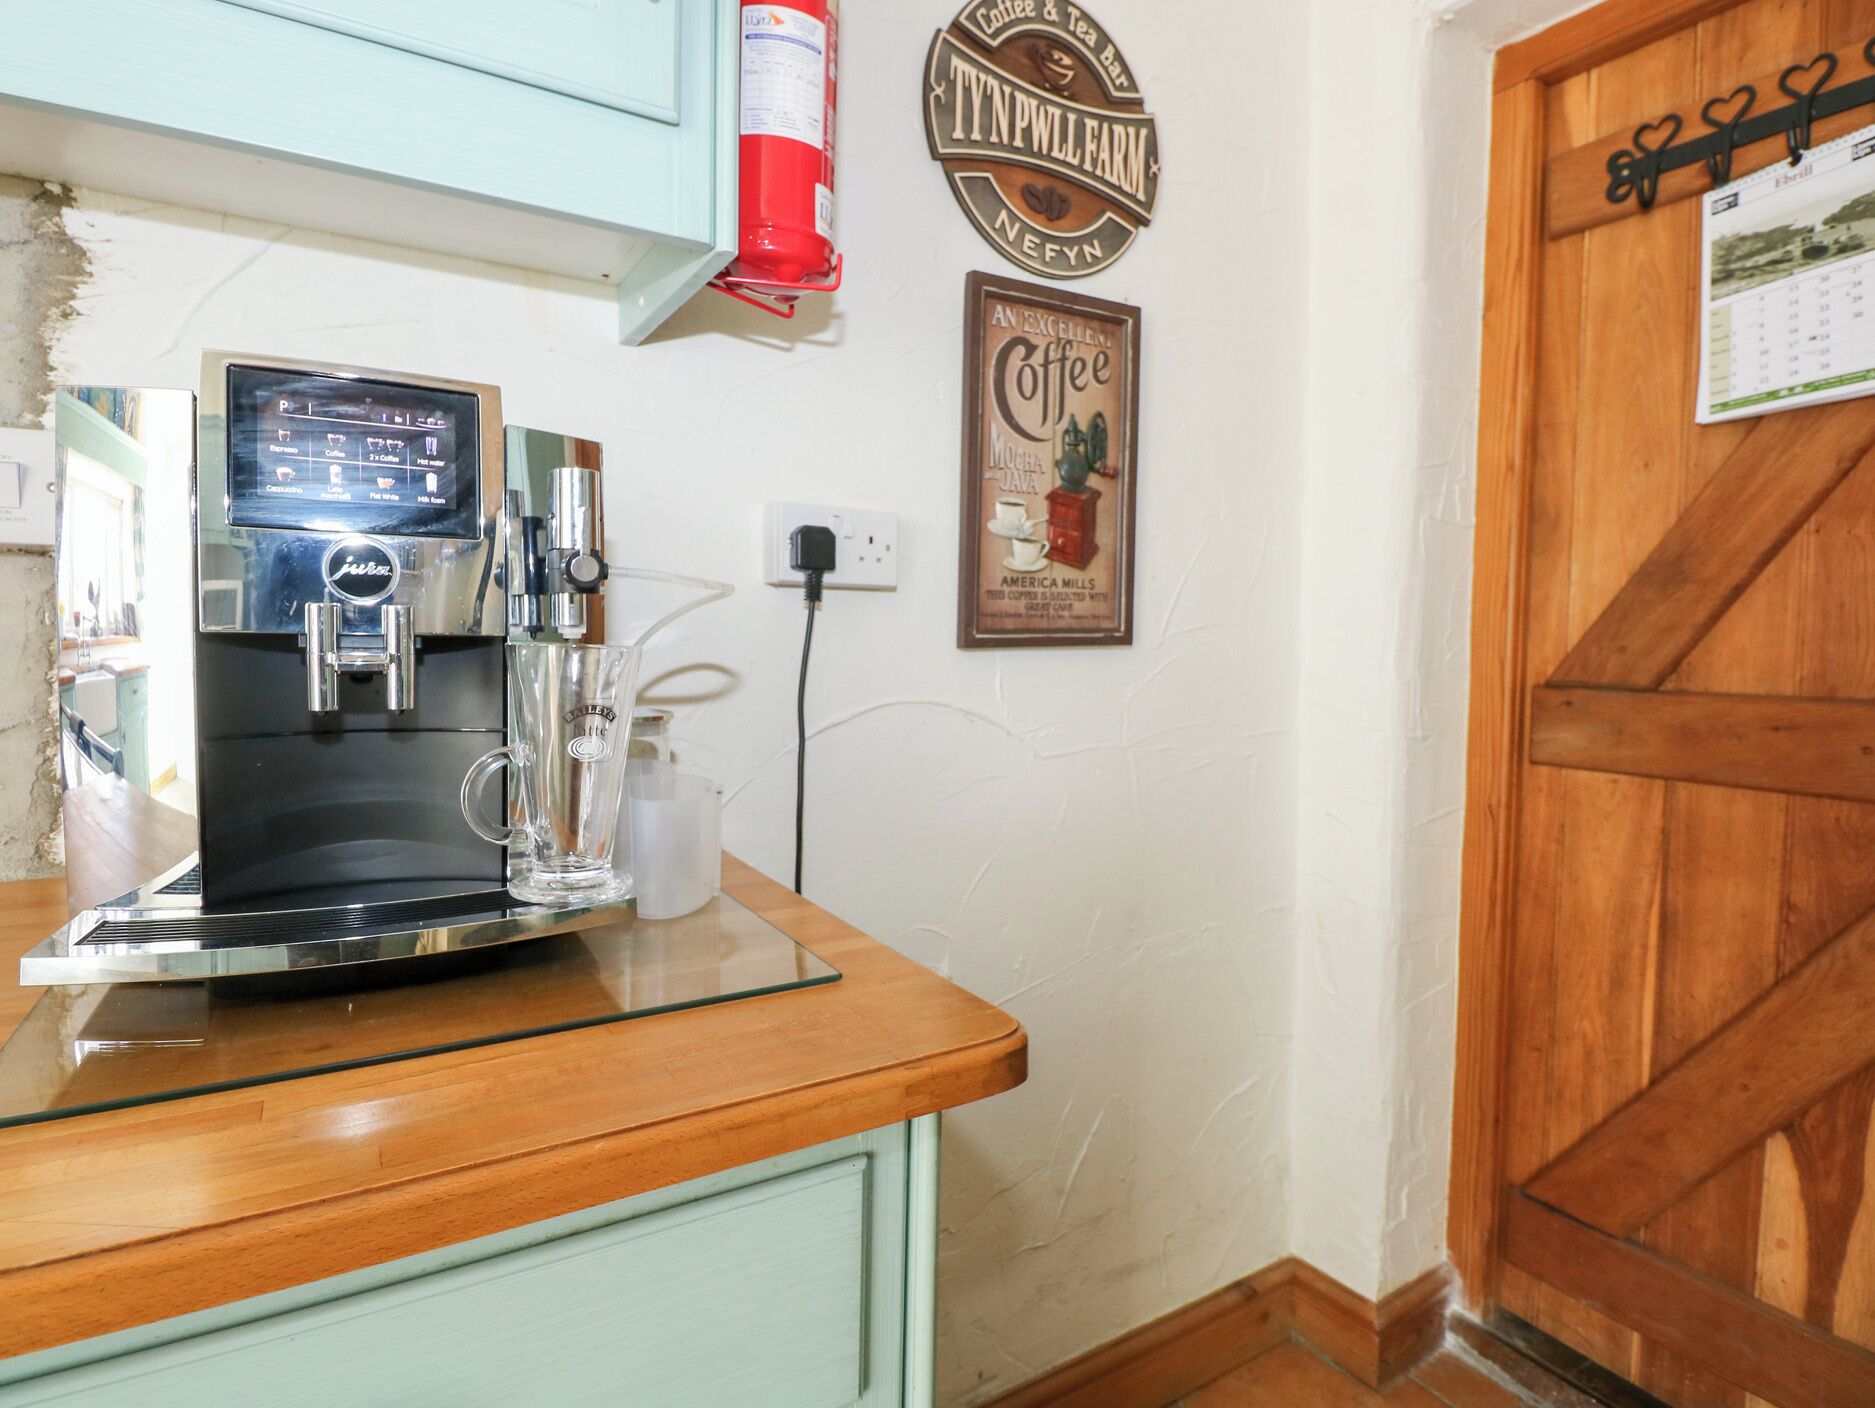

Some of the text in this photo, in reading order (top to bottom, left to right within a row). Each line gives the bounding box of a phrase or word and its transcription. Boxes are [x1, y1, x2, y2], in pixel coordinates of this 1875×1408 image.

[976, 0, 1129, 90] Coffee & Tea Bar
[1013, 90, 1080, 166] PWLL
[1082, 116, 1149, 203] FARM
[993, 208, 1104, 267] NEFYN
[991, 304, 1113, 347] AN EXCELLENT
[992, 335, 1111, 443] Coffee
[279, 400, 289, 412] P
[269, 444, 299, 455] Espresso
[989, 418, 1045, 474] MOCHA
[325, 449, 346, 459] Coffee
[380, 454, 400, 463] Coffee
[417, 457, 446, 468] Hot water
[266, 484, 304, 495] Cappuccino
[999, 471, 1039, 495] JAVA
[369, 492, 400, 502] Flat White
[417, 495, 446, 505] Milk foam
[1000, 575, 1096, 591] AMERICA MILLS
